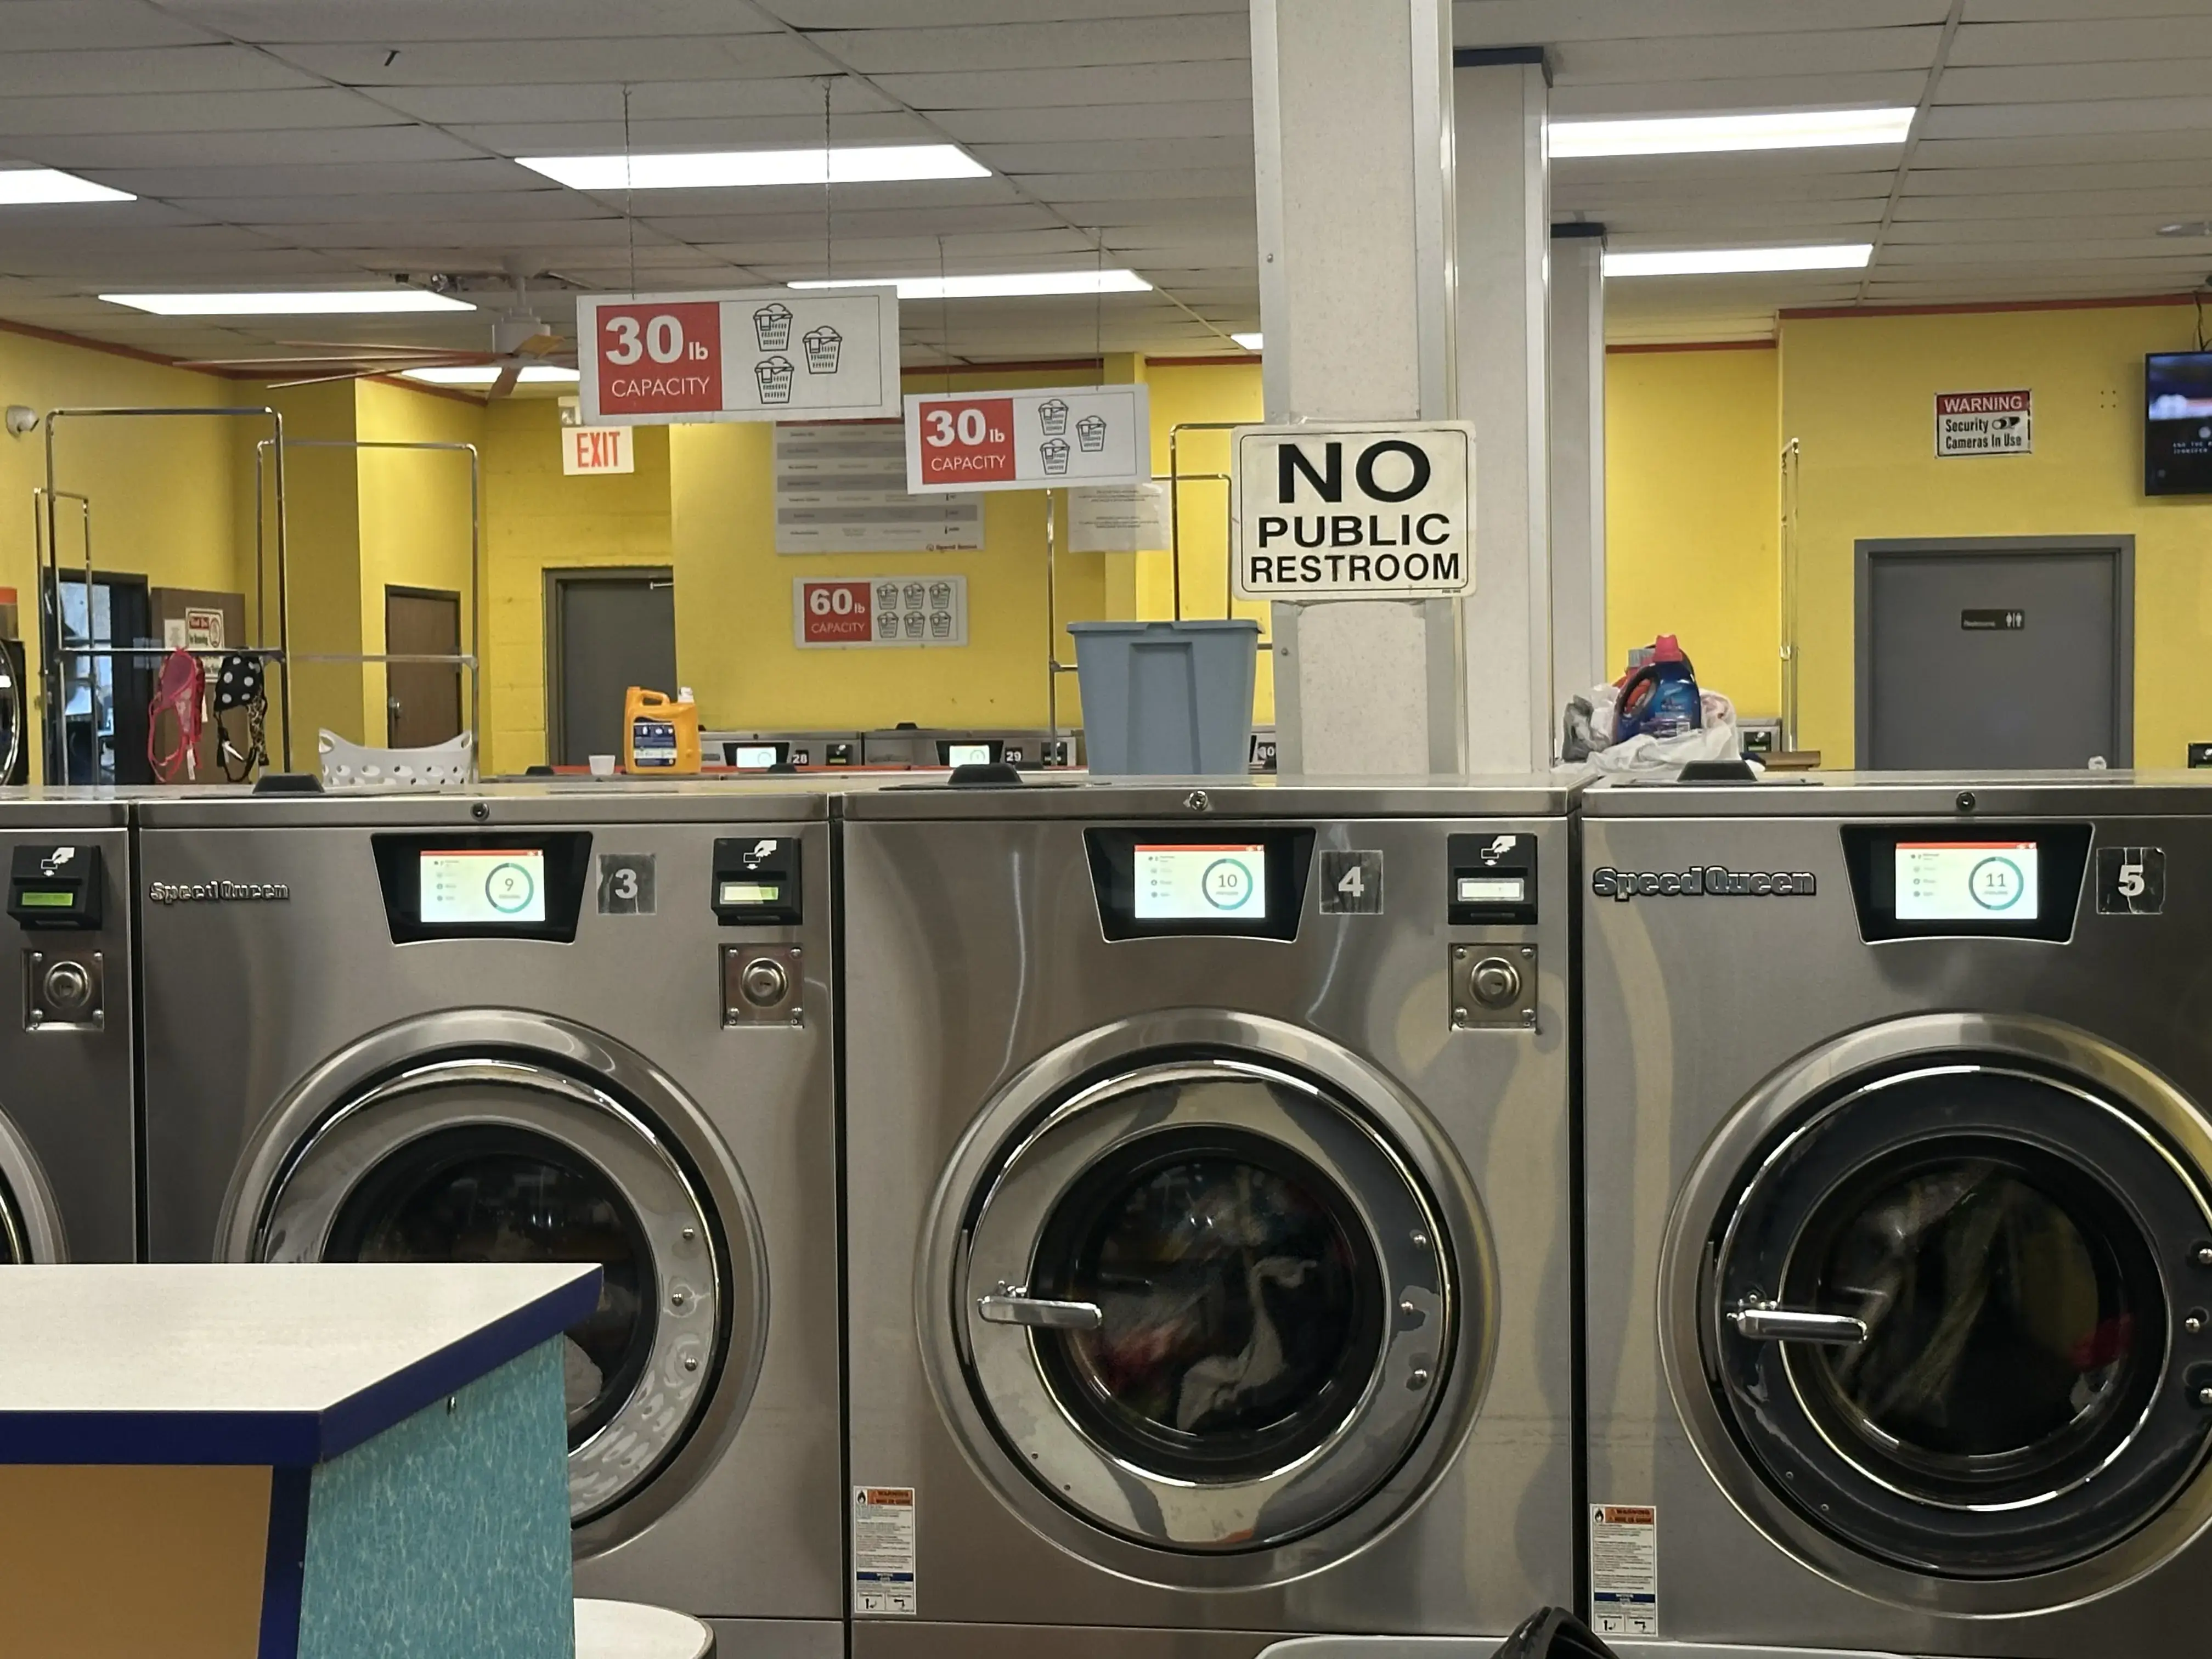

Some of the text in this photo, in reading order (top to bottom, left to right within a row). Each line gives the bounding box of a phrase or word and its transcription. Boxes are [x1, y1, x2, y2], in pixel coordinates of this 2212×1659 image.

[605, 314, 708, 366] 30 lb
[611, 376, 711, 398] CAPACITY
[1944, 395, 2023, 413] WARNING
[926, 408, 1006, 448] 30 lb
[1945, 417, 1989, 434] Security
[576, 431, 620, 469] EXIT
[1945, 432, 2022, 450] Cameras In Use
[930, 454, 1007, 472] CAPACITY
[1277, 439, 1431, 504] NO
[1258, 513, 1450, 548] PUBLIC
[1250, 552, 1459, 584] RESTROOM
[809, 588, 866, 615] 60 lb
[811, 622, 866, 634] CAPACITY
[792, 753, 808, 764] 28
[1006, 751, 1022, 762] 29
[150, 879, 290, 905] Speed Queen
[504, 877, 514, 892] 9
[614, 868, 638, 899] 3
[1218, 873, 1238, 888] 10
[1338, 866, 1364, 898] 4
[1592, 865, 1817, 902] Speed Queen
[1985, 872, 2006, 887] 11
[2117, 864, 2145, 896] 5
